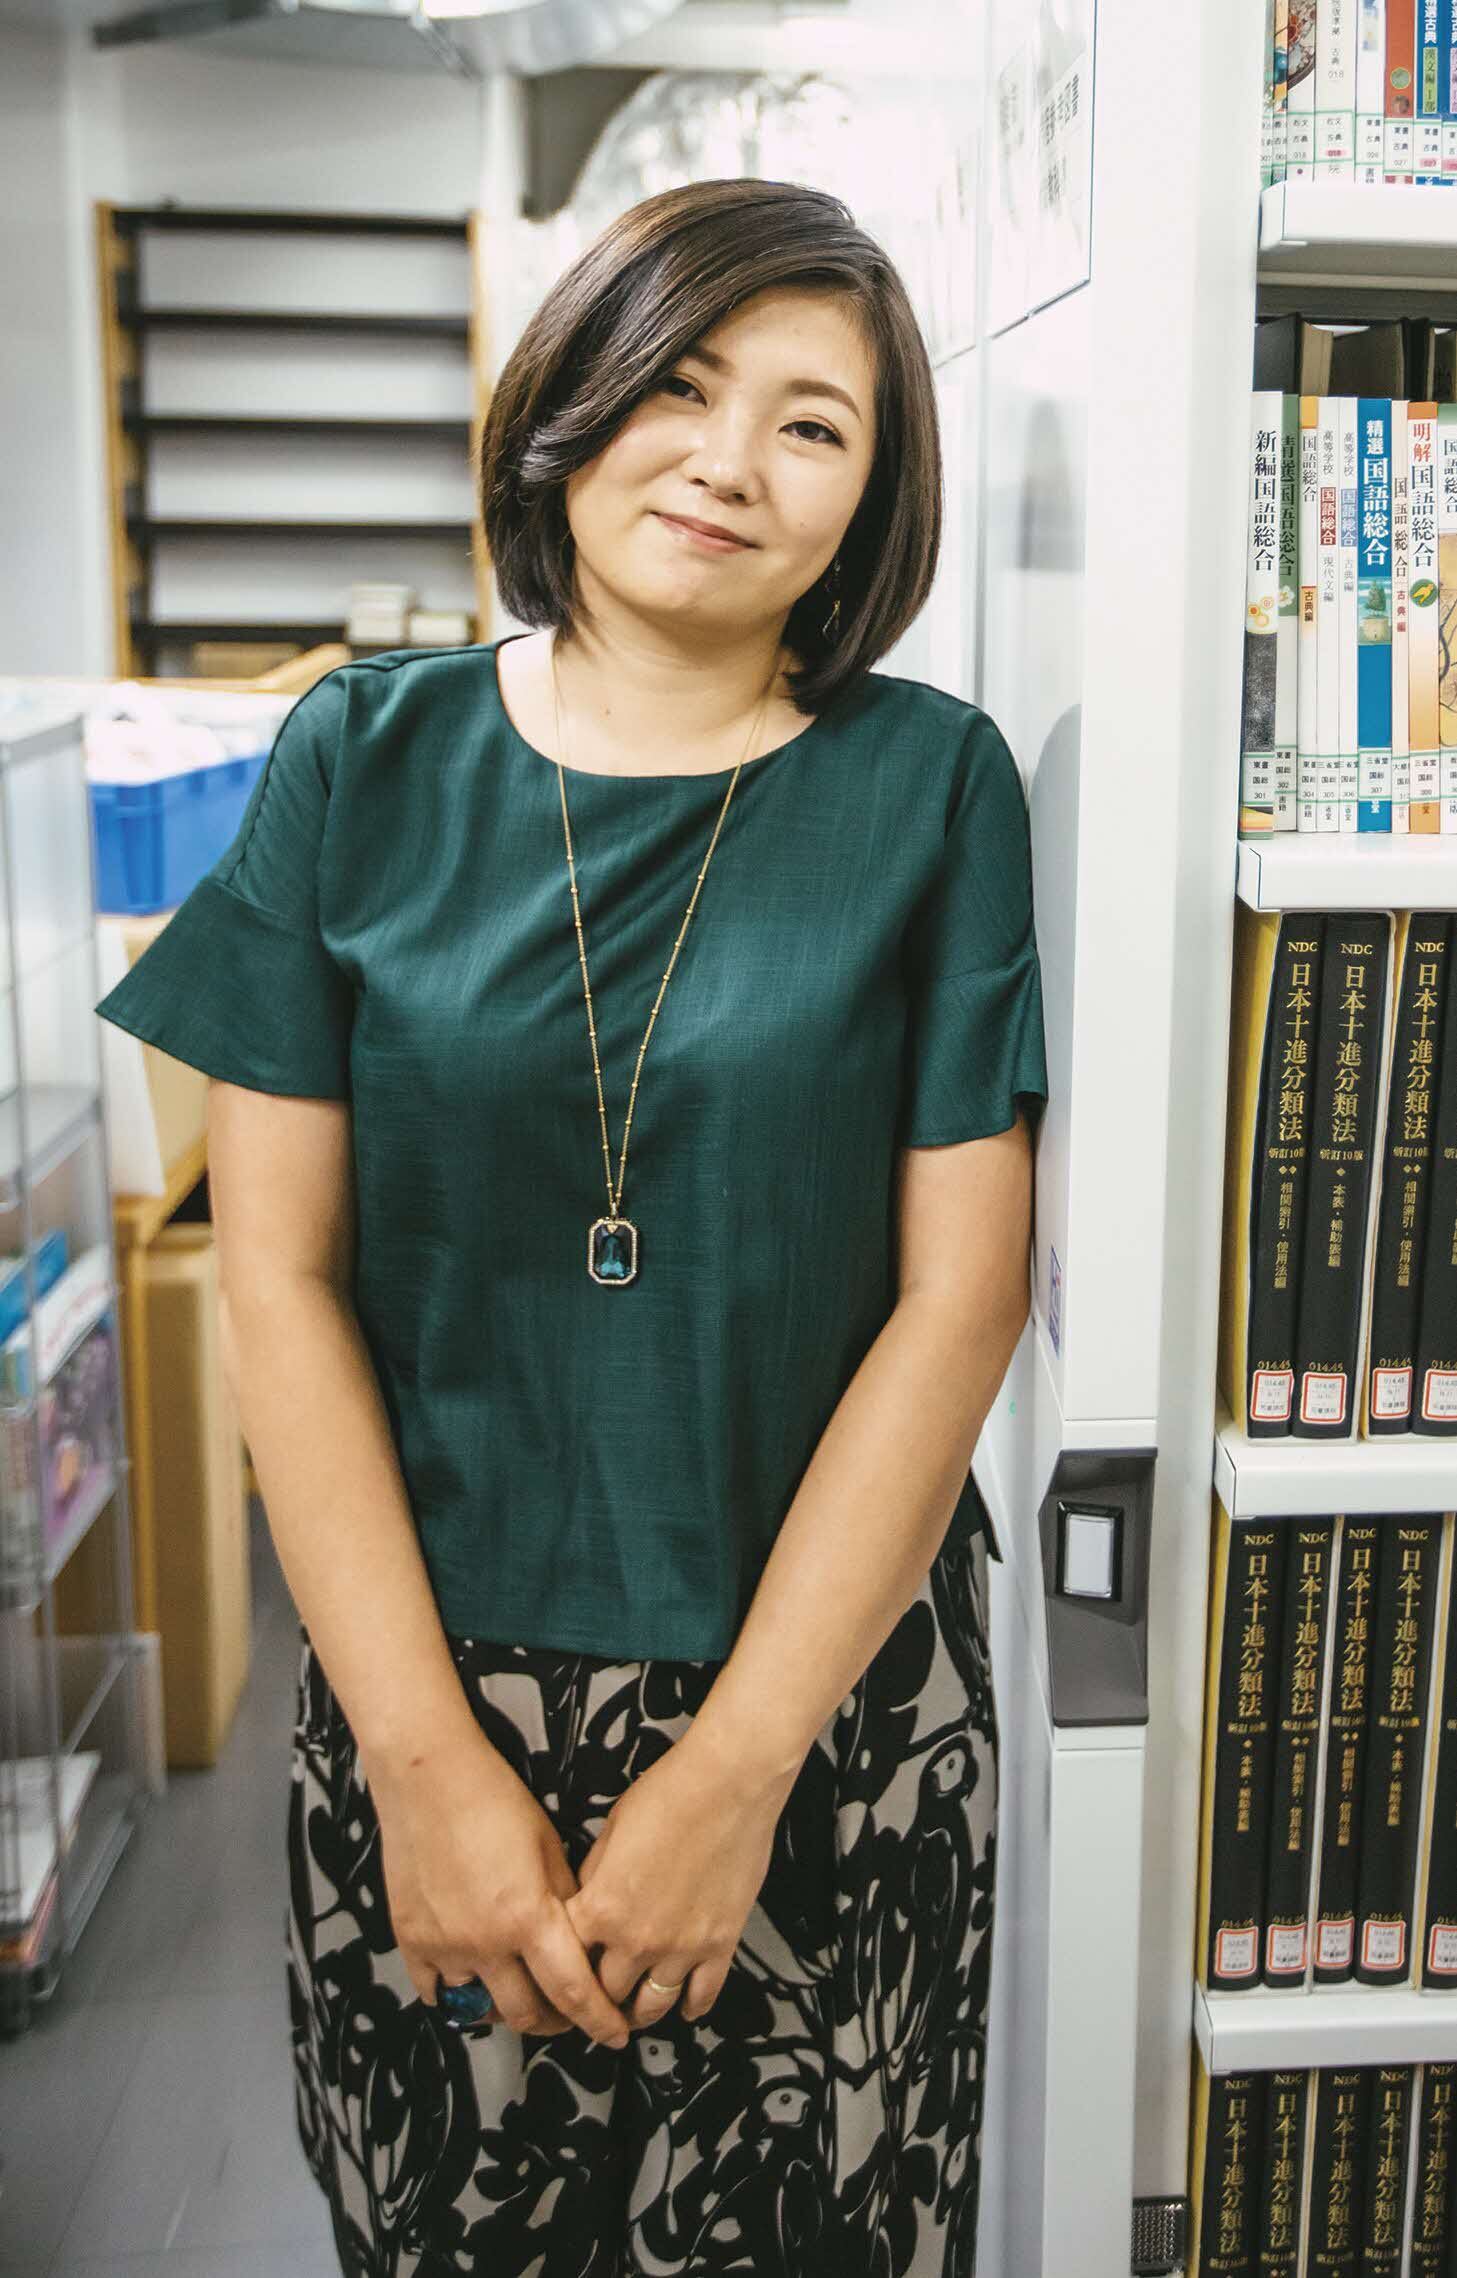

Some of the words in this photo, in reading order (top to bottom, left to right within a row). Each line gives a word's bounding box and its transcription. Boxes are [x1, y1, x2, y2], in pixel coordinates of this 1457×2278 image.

[1302, 436, 1317, 502] 国語総合
[1322, 430, 1334, 475] 高等学校
[1253, 430, 1277, 571] 新編国語総合
[1321, 488, 1336, 545] 国語総合
[1342, 490, 1357, 546] 国語総合
[1394, 477, 1408, 577] 国語総合
[1254, 791, 1266, 799] 301
[1288, 941, 1318, 952] NDC
[1340, 943, 1373, 955] NDC
[1415, 941, 1444, 952] NDC
[1279, 963, 1312, 1141] 日本十進分類法
[1331, 964, 1367, 1143] 日本十進分類法
[1403, 963, 1438, 1140] 日本十進分類法
[1308, 1361, 1343, 1372] 014.45
[1244, 1533, 1274, 1545] NDC
[1299, 1532, 1328, 1544] NDC
[1349, 1528, 1377, 1539] NDC
[1399, 1529, 1429, 1541] NDC
[1238, 1554, 1269, 1717] 日本十進分類法
[1291, 1552, 1323, 1715] 日本十進分類法
[1340, 1548, 1371, 1711] 日本十進分類法
[1390, 1549, 1423, 1712] 日本十進分類法
